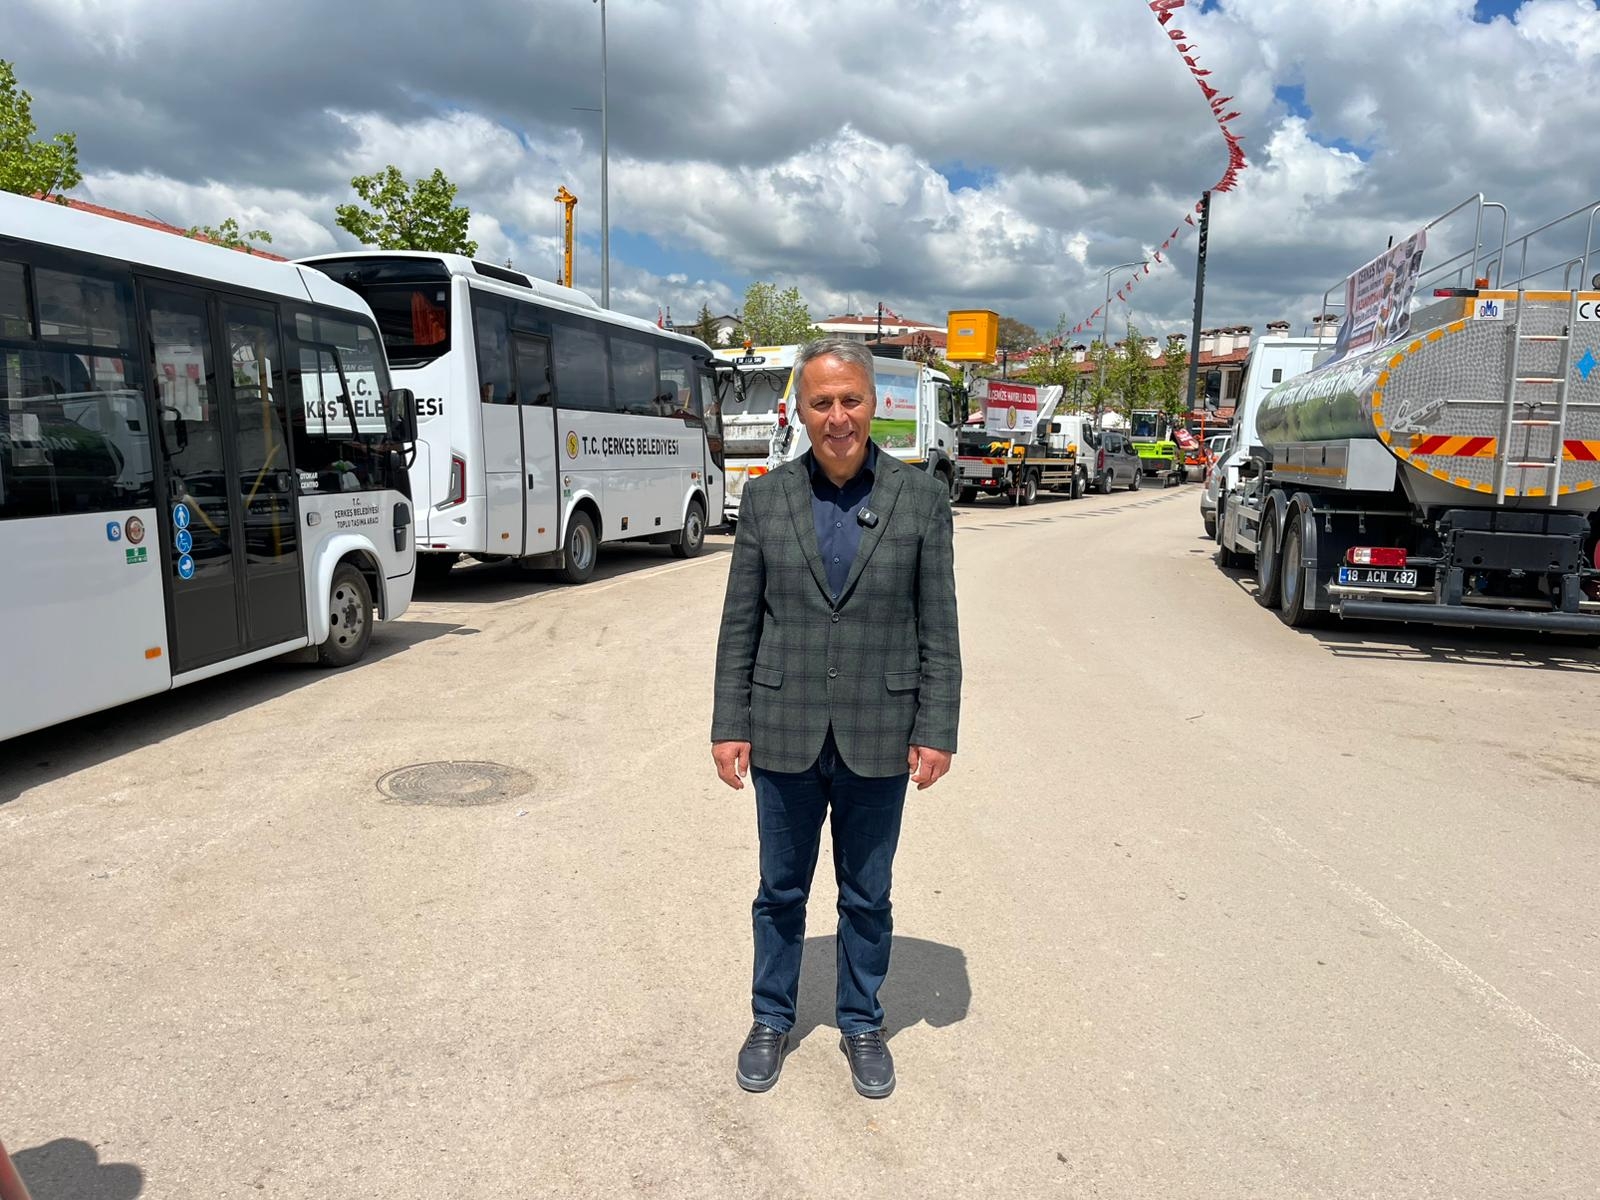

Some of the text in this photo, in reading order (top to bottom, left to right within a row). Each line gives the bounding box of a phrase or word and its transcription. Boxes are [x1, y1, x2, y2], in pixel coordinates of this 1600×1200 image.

[306, 401, 337, 420] KEŞ
[582, 436, 679, 457] T.C. ÇERKEŞ BELEDİYESİ
[1347, 570, 1414, 584] 18 ACN 482
